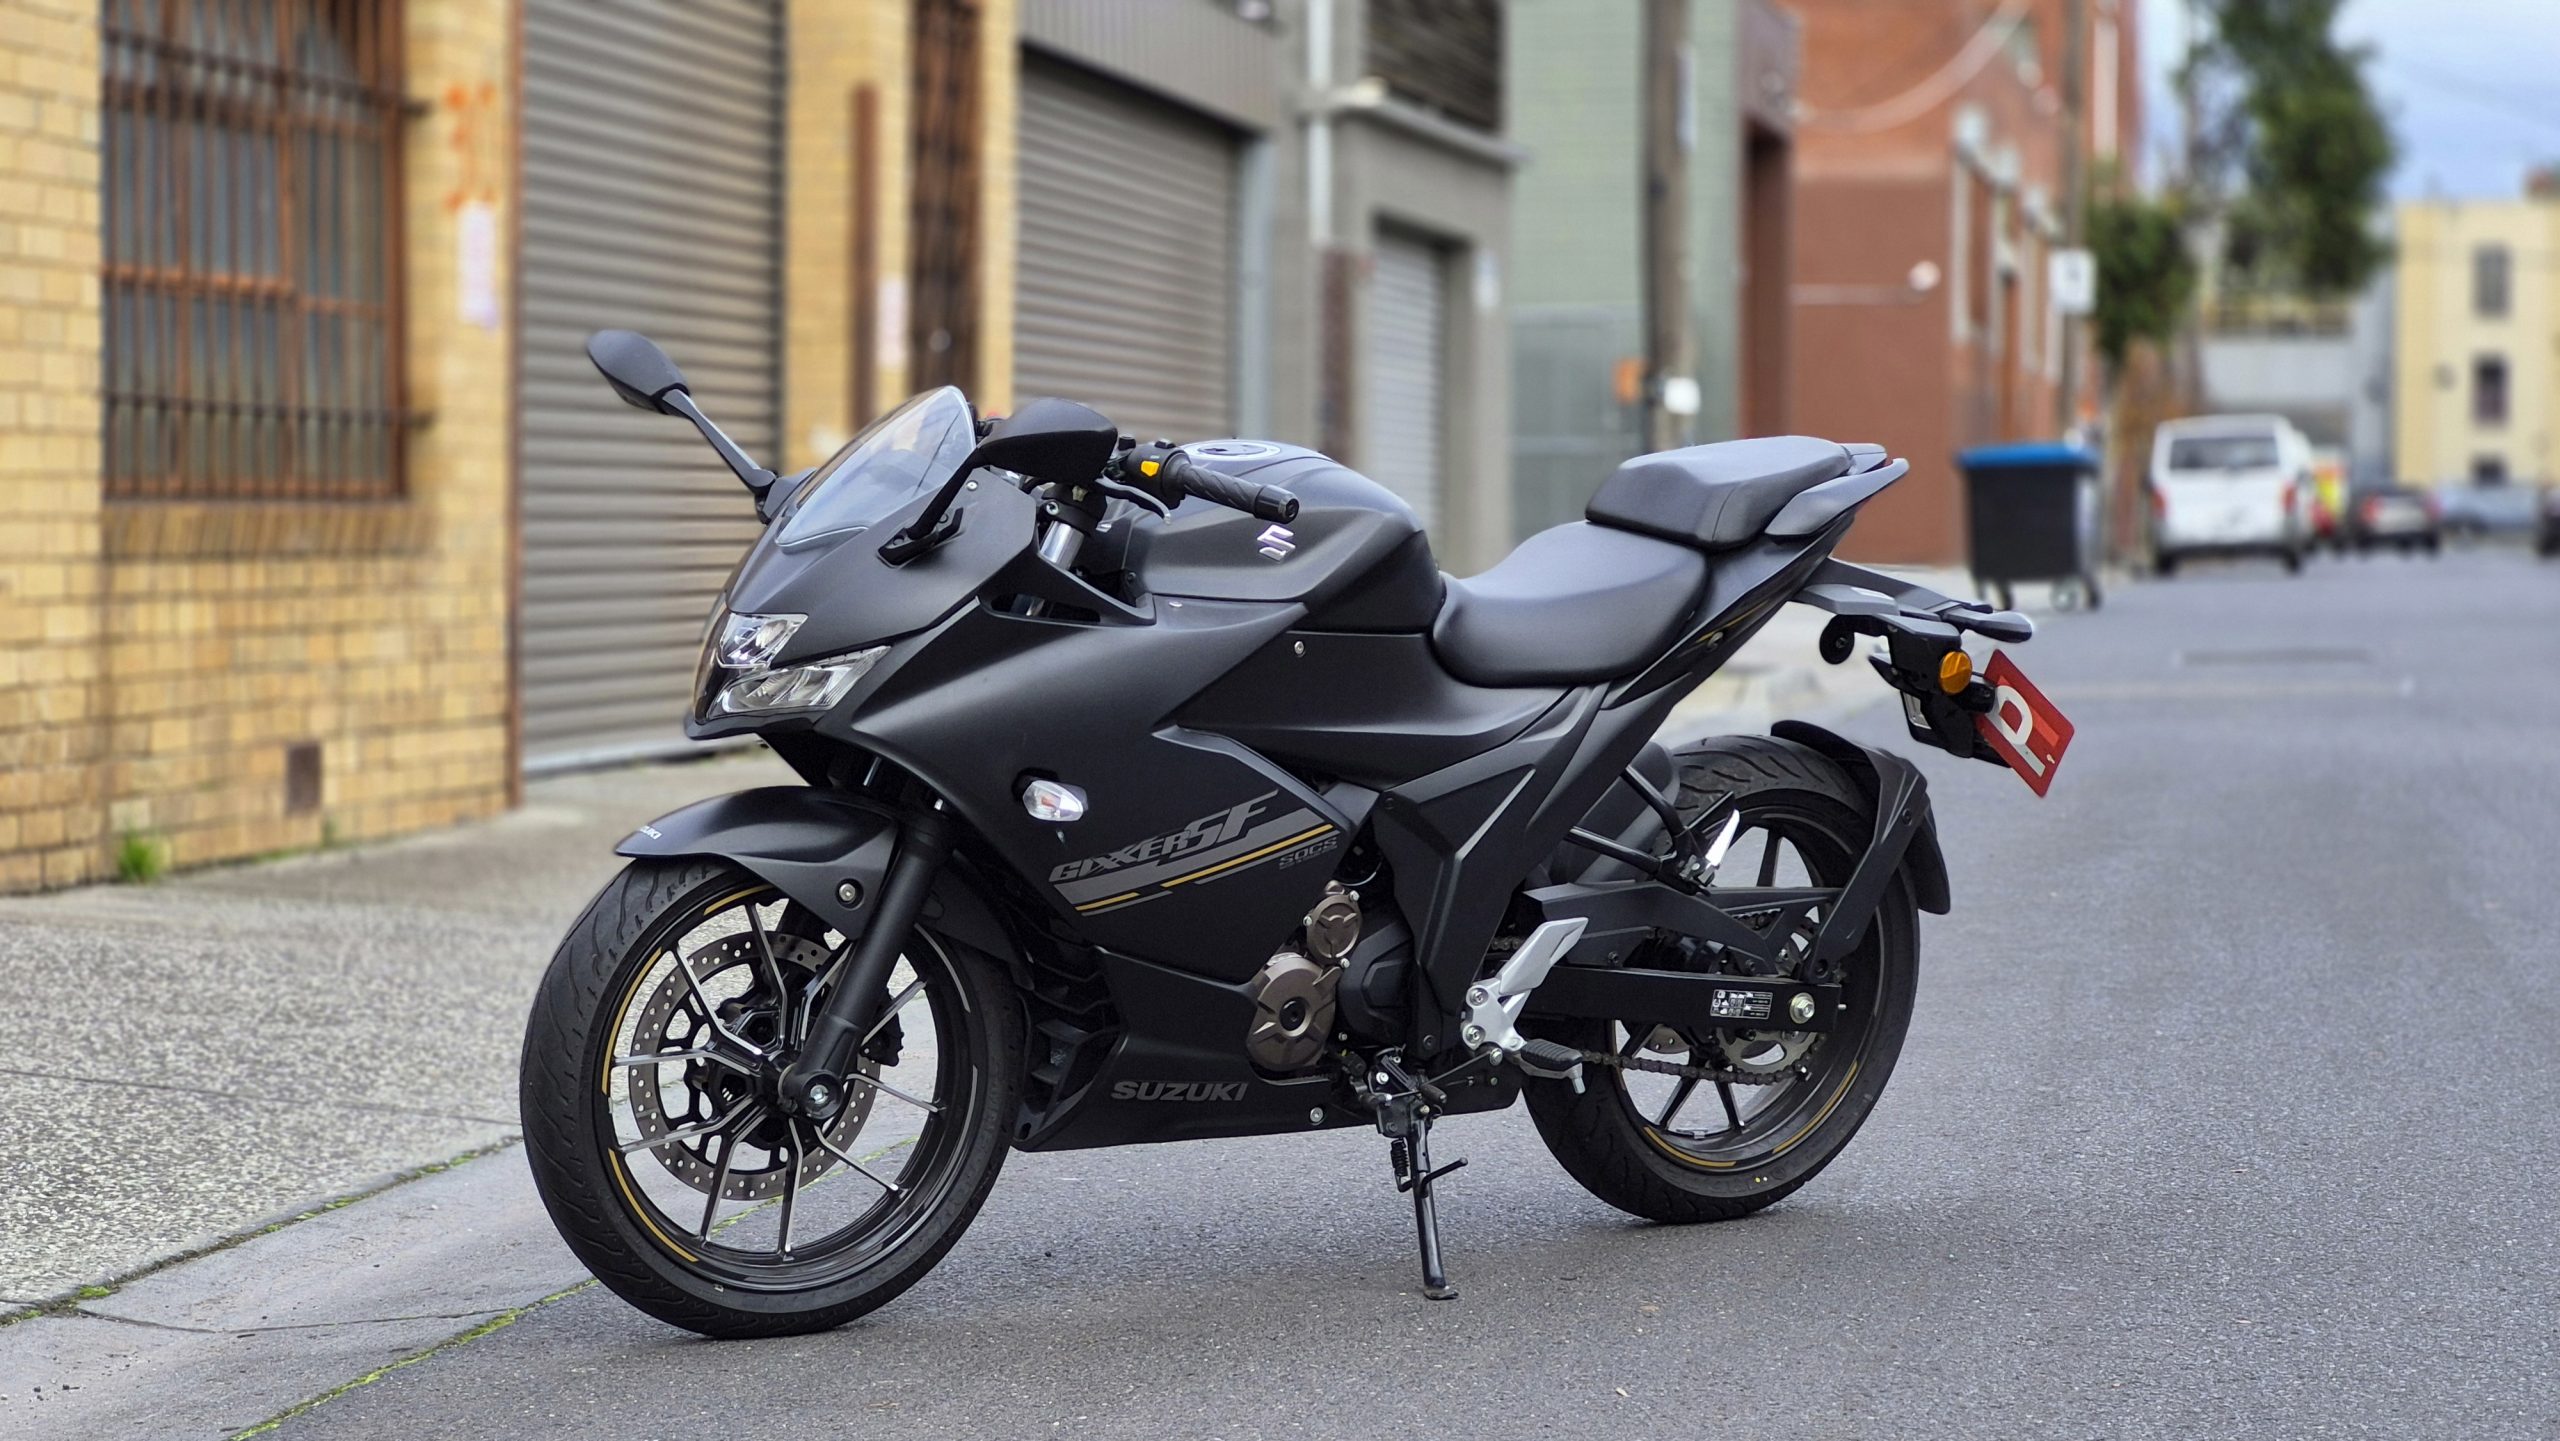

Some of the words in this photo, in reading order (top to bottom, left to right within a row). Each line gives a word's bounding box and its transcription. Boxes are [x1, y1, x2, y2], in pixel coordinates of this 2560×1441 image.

[1986, 685, 2046, 777] P
[1049, 829, 1190, 882] GIXXER
[1169, 789, 1278, 853] SF
[1279, 837, 1338, 867] SOCS
[1111, 1081, 1249, 1101] SUZUKI
